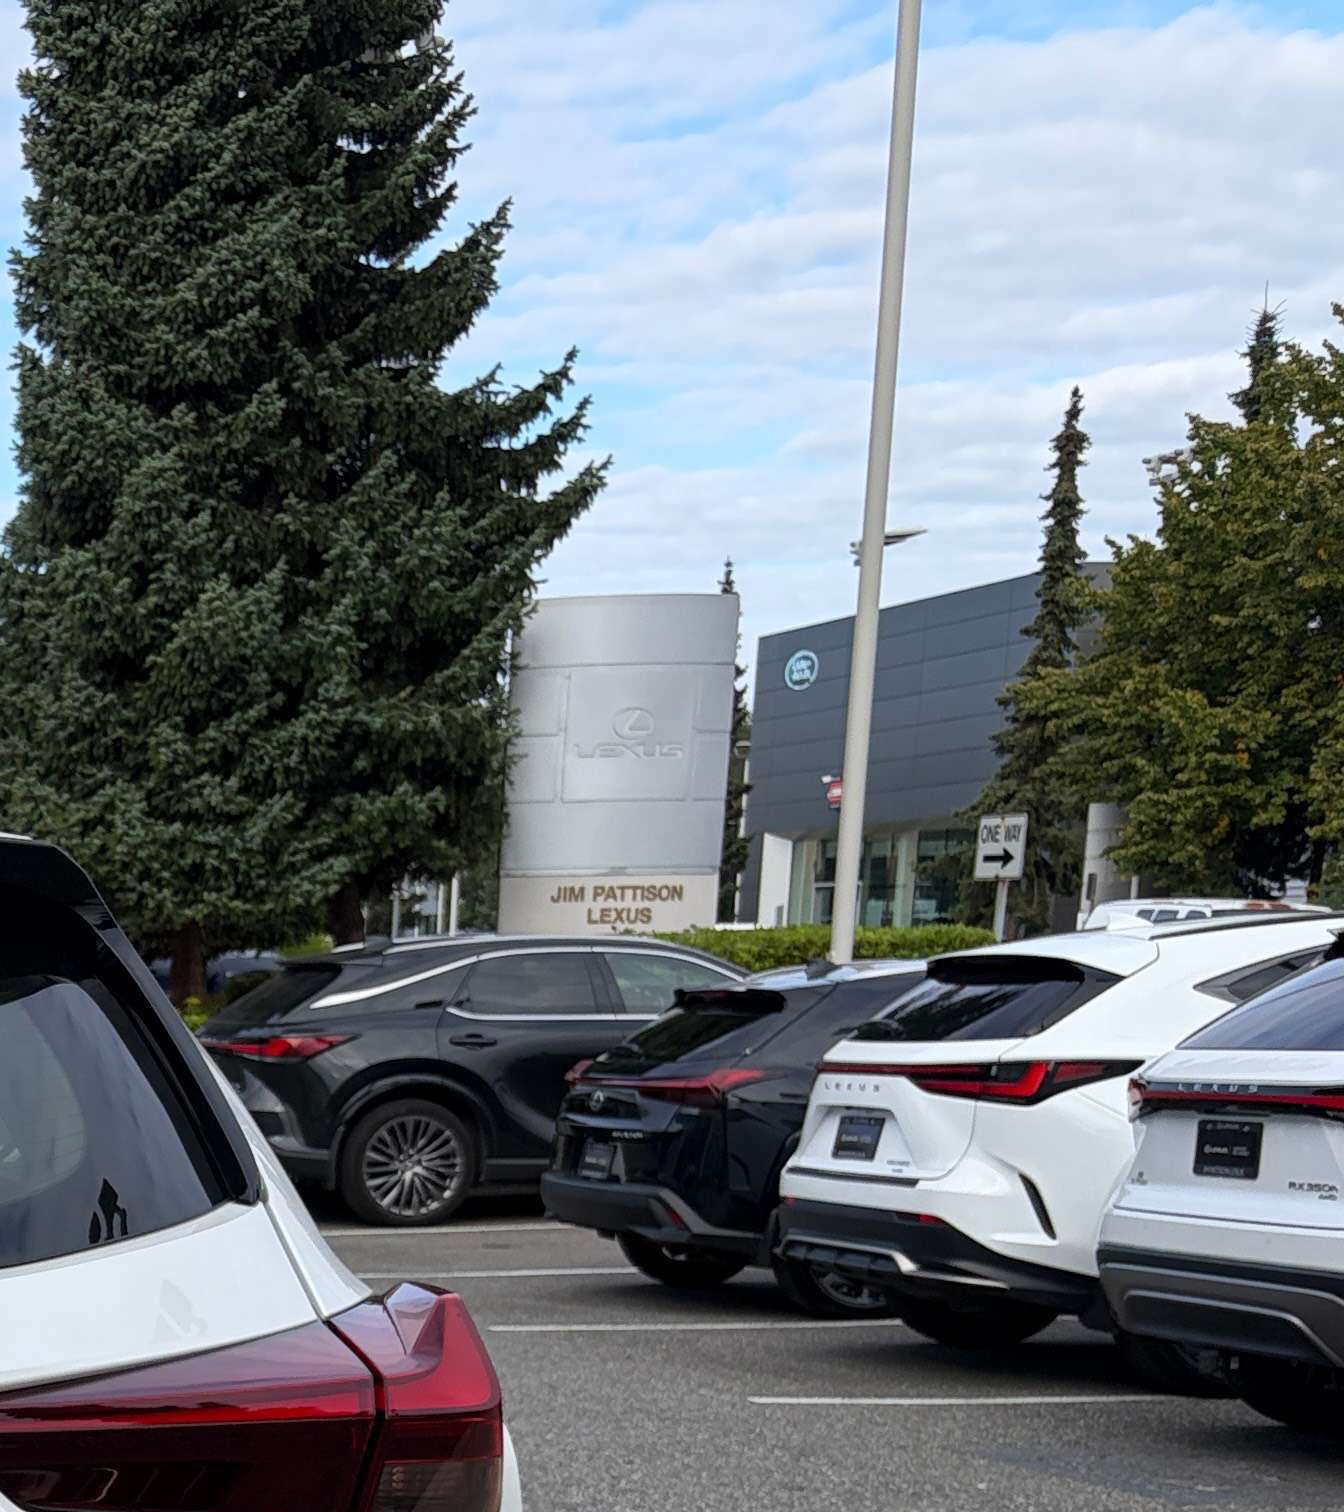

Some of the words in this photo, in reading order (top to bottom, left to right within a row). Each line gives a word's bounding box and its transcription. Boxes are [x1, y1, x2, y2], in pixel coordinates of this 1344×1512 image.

[981, 824, 1001, 843] ONE
[1004, 823, 1022, 842] WAY
[550, 885, 585, 903] JIM
[592, 884, 684, 902] PATTISON
[586, 907, 652, 924] LEXUS
